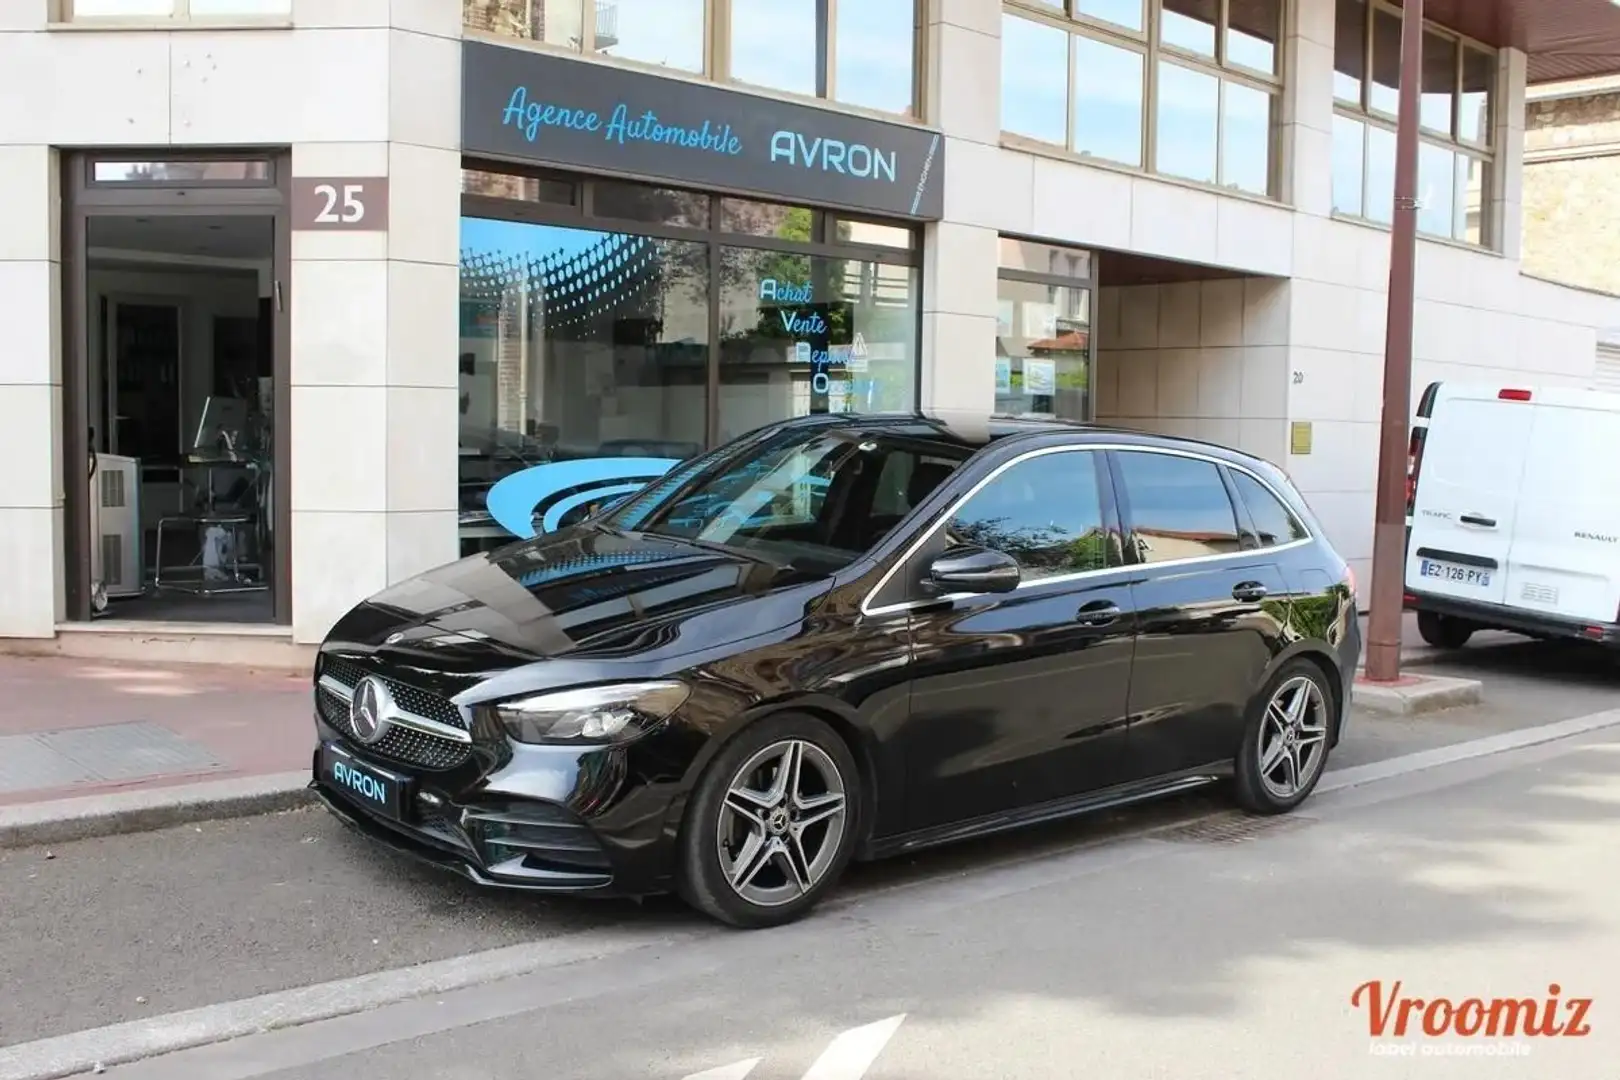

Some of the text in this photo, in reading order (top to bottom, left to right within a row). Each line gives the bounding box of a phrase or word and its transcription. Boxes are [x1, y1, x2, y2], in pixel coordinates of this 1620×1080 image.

[503, 86, 896, 182] Agence Automobile AVRON
[314, 185, 364, 222] 25
[760, 279, 813, 303] Achat
[780, 310, 828, 334] Vente
[1293, 371, 1304, 384] 20
[1574, 531, 1620, 543] RENAULT
[334, 761, 386, 804] AVRON
